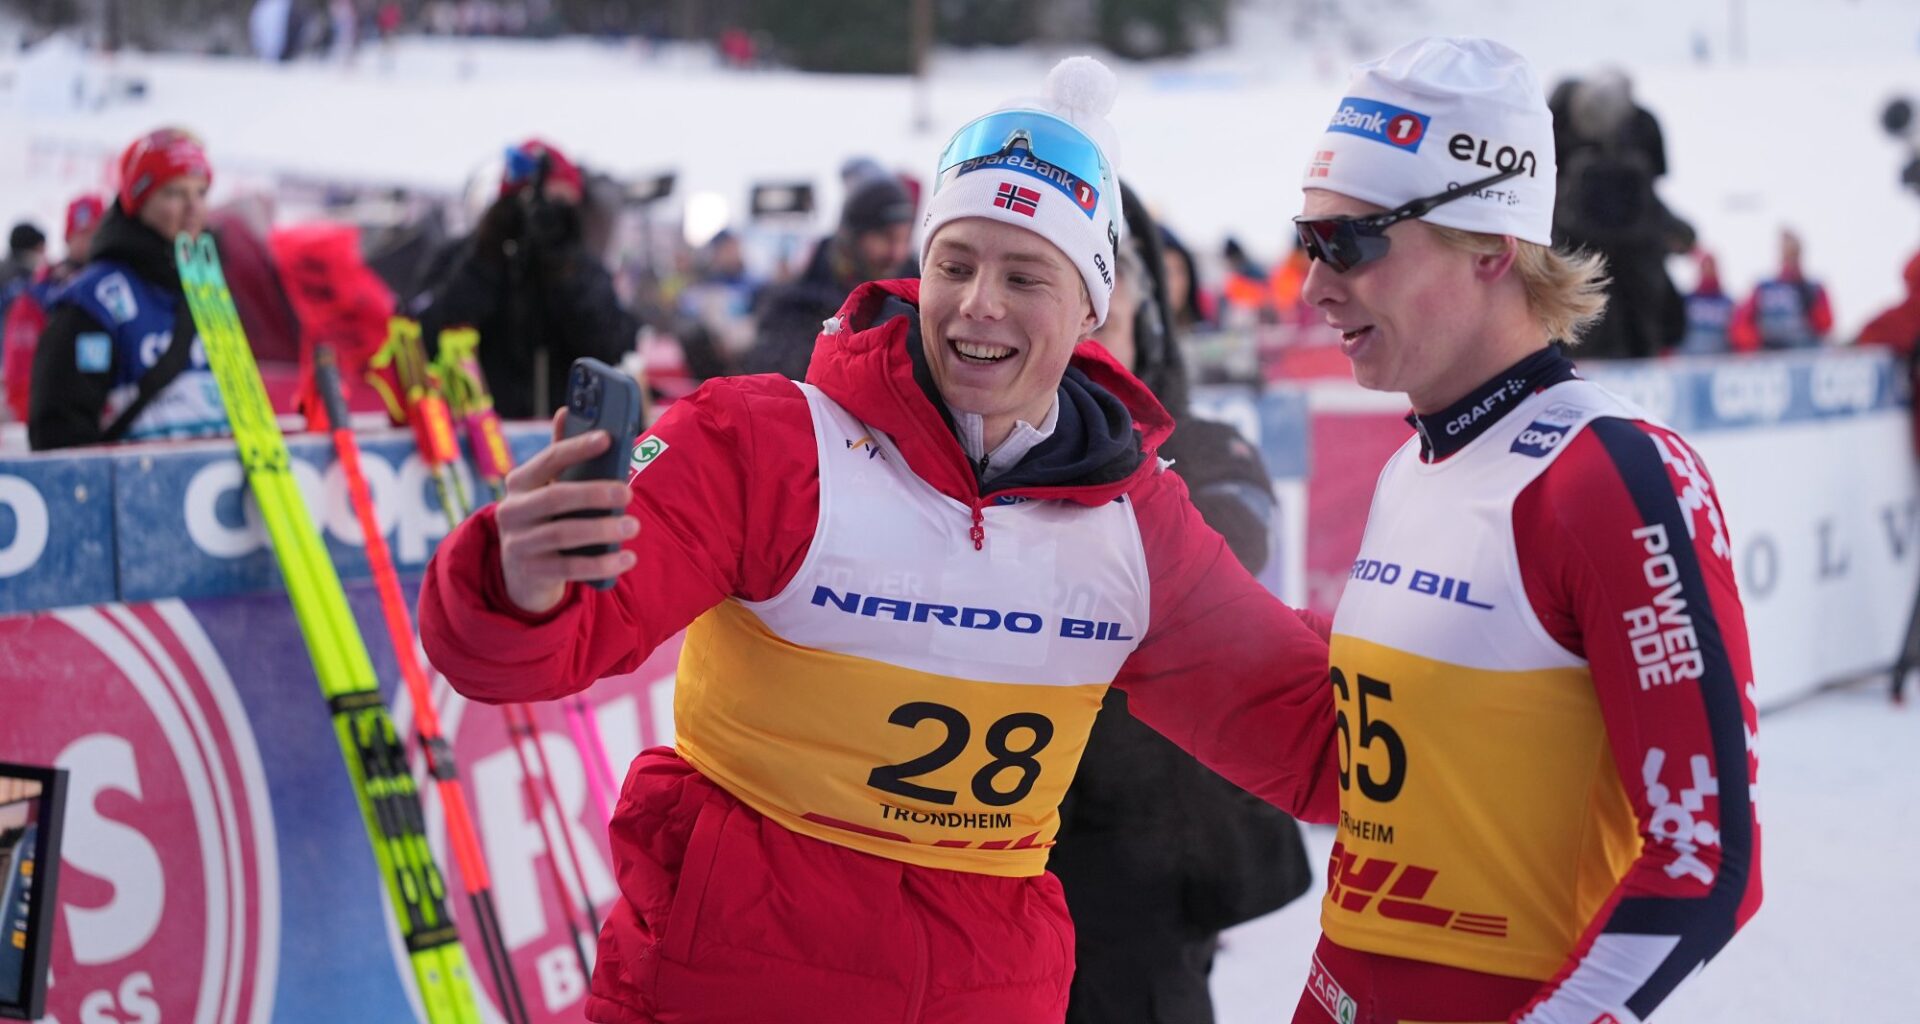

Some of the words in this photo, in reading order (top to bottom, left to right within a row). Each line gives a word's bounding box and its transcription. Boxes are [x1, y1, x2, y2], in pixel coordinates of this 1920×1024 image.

[1447, 181, 1505, 202] CAFT
[1446, 387, 1507, 435] CRAFT
[1519, 430, 1562, 450] coop
[811, 585, 1043, 634] NARDO
[1059, 617, 1134, 641] BIL
[1408, 570, 1496, 610] BIL
[1632, 523, 1705, 682] POWER
[1623, 605, 1674, 691] ADE
[867, 701, 1054, 806] 28
[1330, 666, 1407, 803] 65
[880, 803, 1012, 829] TRONDHEIM
